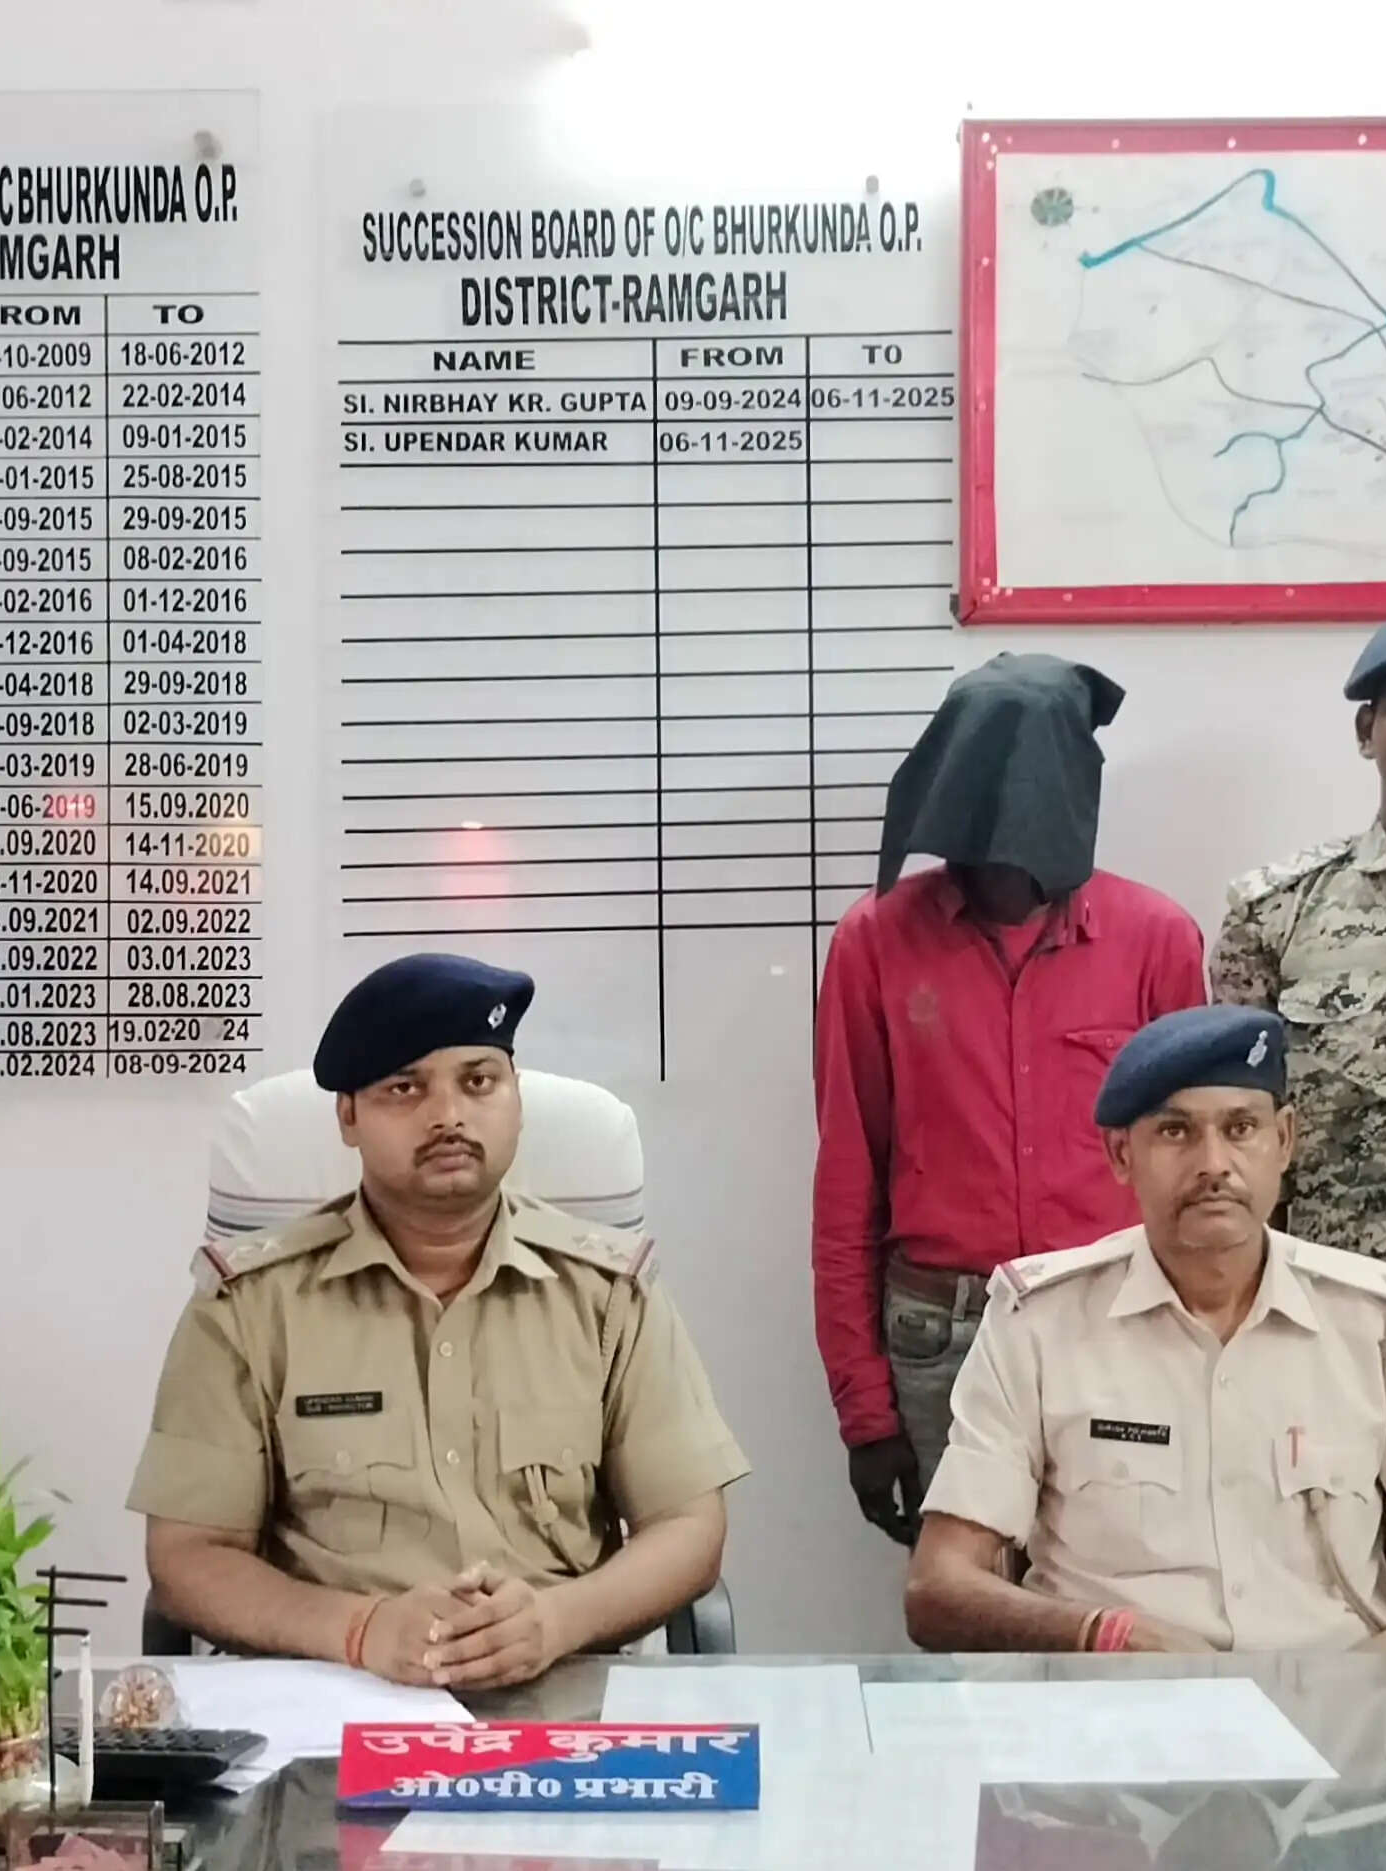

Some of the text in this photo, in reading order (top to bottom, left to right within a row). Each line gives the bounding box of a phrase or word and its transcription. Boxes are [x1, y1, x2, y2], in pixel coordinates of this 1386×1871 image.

[18, 165, 187, 224] BHURKUNDA
[195, 161, 237, 223] O.P.
[363, 202, 921, 263] SUCCESSION BOARD OF O/C BHURKUNDA O.P.
[461, 271, 786, 326] DISTRICT-RAMGARH
[152, 304, 204, 324] TO
[121, 341, 245, 366] 18-06-2012
[434, 350, 535, 371] NAME
[681, 346, 783, 367] FROM
[123, 382, 246, 408] 22-02-2014
[344, 387, 955, 414] SI. NIRBHAY KR. GUPTA 09-09-2024 06-11-2025
[123, 424, 246, 448] 09-01-2015
[344, 430, 802, 452] SI. UPENDAR KUMAR 06-11-2025
[124, 464, 246, 488] 25-08-2015
[123, 506, 246, 530] 29-09-2015
[124, 545, 247, 570] 08-02-2016
[124, 587, 246, 612] 01-12-2016
[123, 629, 246, 654] 01-04-2018
[125, 670, 247, 696] 29-09-2018
[124, 710, 247, 736] 02-03-2019
[125, 753, 248, 777] 28-06-2019
[126, 792, 249, 818] 15.09.2020
[126, 832, 248, 857] 14-11-2020
[127, 868, 249, 895] 14.09.2021
[127, 908, 250, 934] 02.09.2022
[128, 945, 251, 971] 03.01.2023
[128, 982, 250, 1008] 28.08.2023
[114, 1053, 247, 1075] 08-09-2024
[546, 1729, 750, 1763] कुमार
[574, 1771, 719, 1799] प्रभारी
